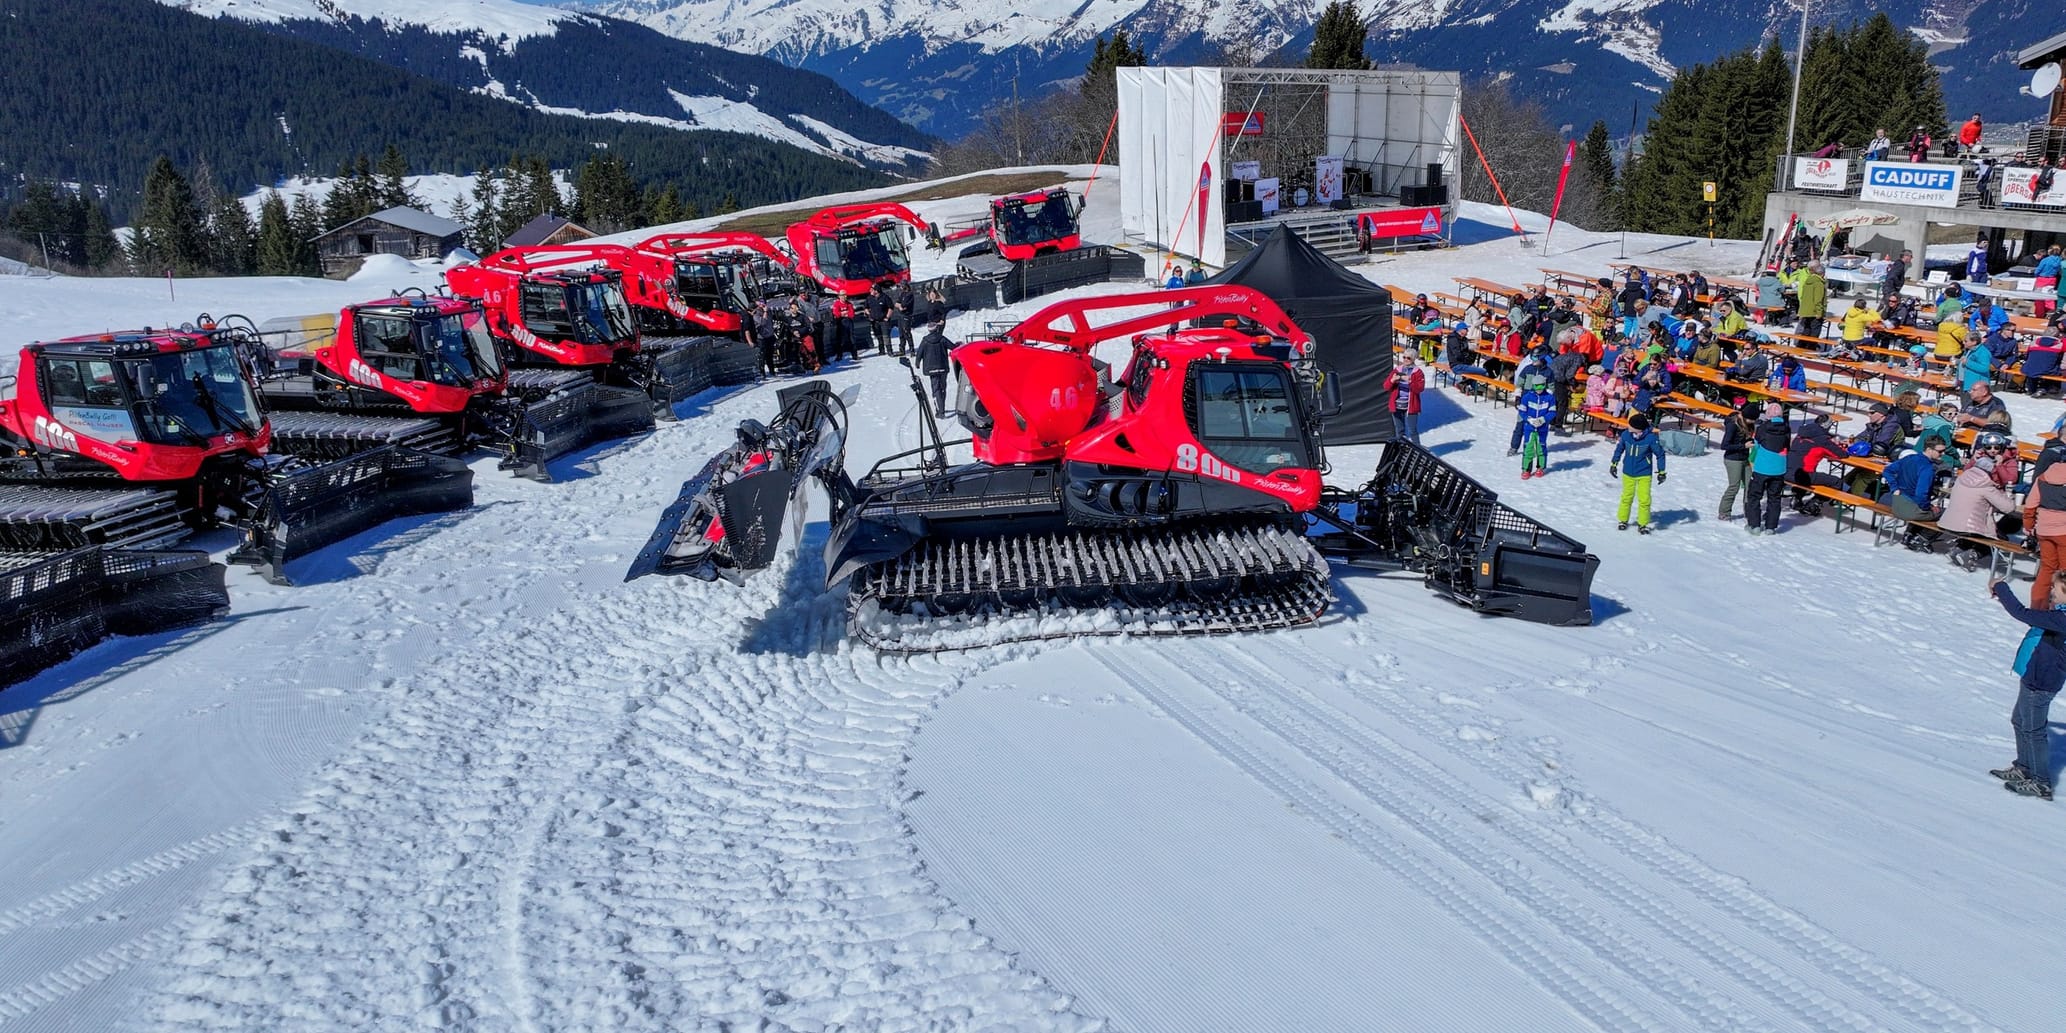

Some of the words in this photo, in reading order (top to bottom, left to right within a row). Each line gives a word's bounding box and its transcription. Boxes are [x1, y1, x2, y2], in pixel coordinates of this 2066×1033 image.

[1873, 169, 1950, 188] CADUFF
[1872, 189, 1945, 201] HAUSTECHNIK
[1213, 293, 1249, 304] PistenBully
[34, 415, 80, 453] 400
[91, 446, 130, 466] PistenBully
[1176, 443, 1241, 483] 800
[1253, 477, 1307, 496] PistenBully
